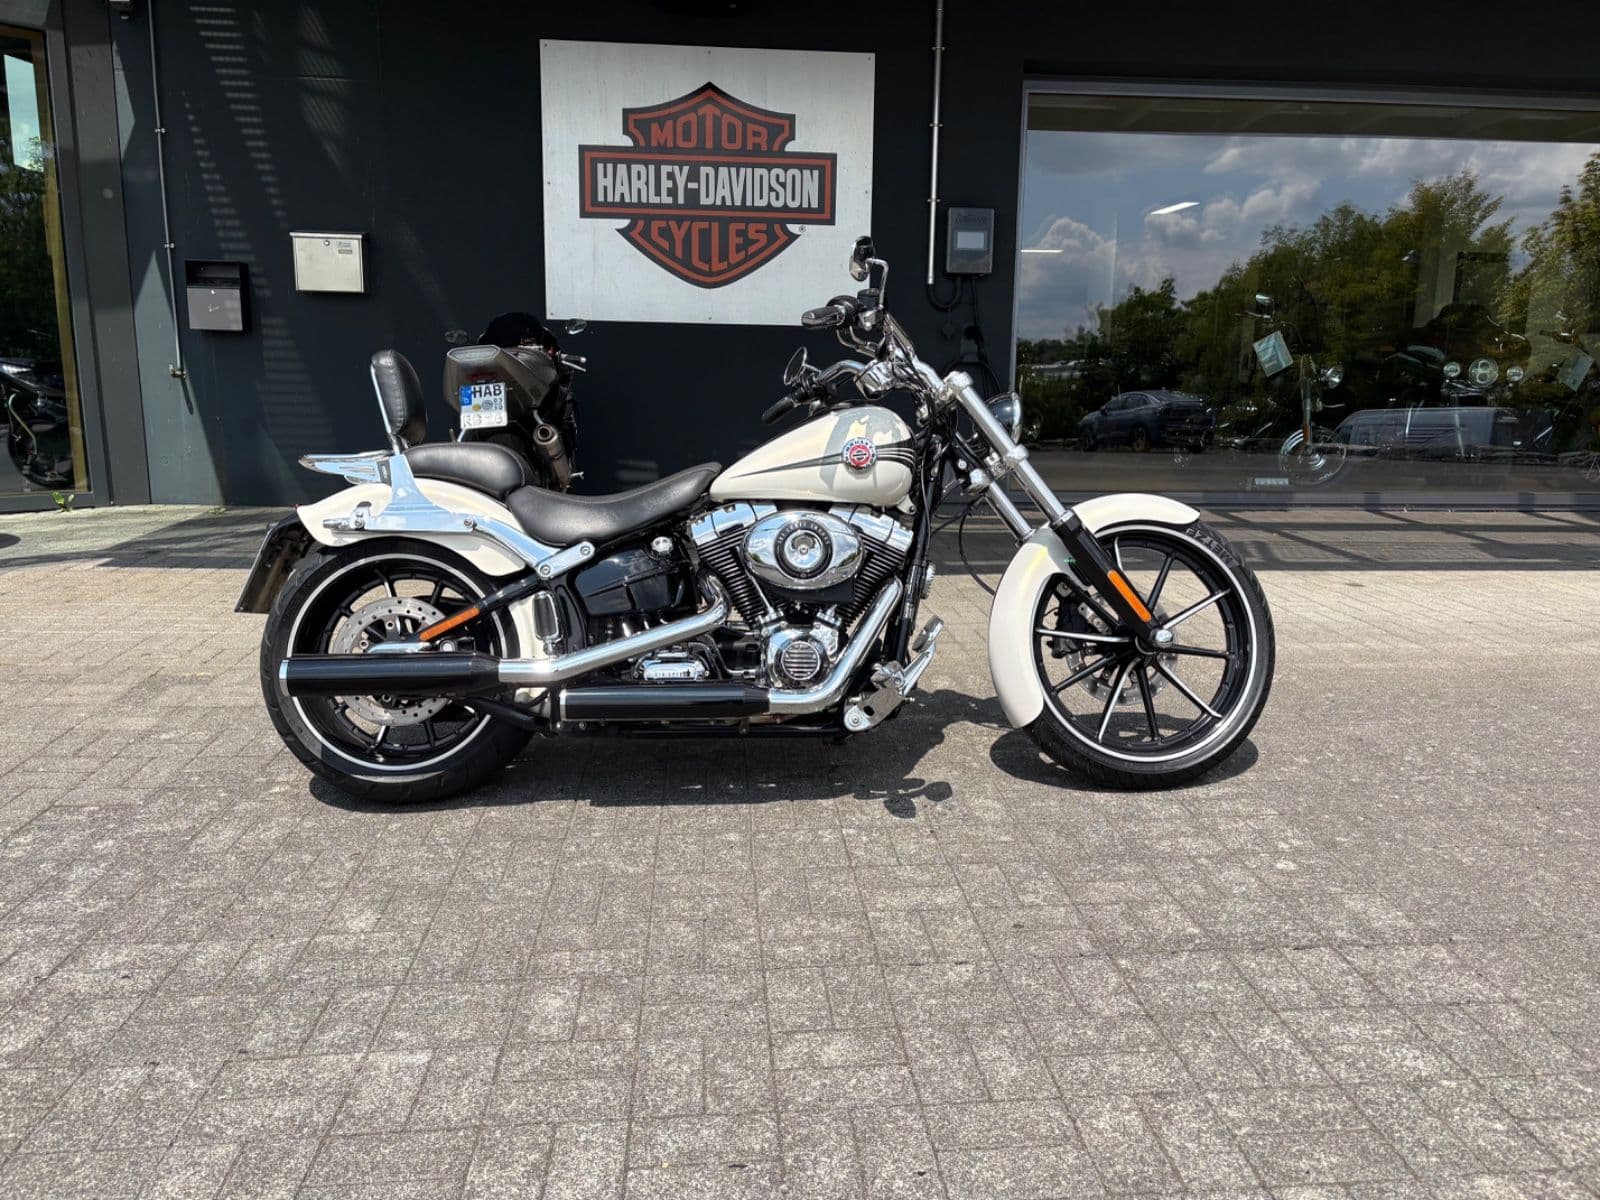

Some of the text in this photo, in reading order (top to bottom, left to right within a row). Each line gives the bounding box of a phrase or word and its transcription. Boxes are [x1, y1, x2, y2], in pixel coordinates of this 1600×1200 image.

[650, 103, 769, 151] MOTOR
[596, 162, 820, 209] HARLEY-DAVIDSON
[650, 219, 768, 272] CYCLES
[473, 384, 502, 399] HAB
